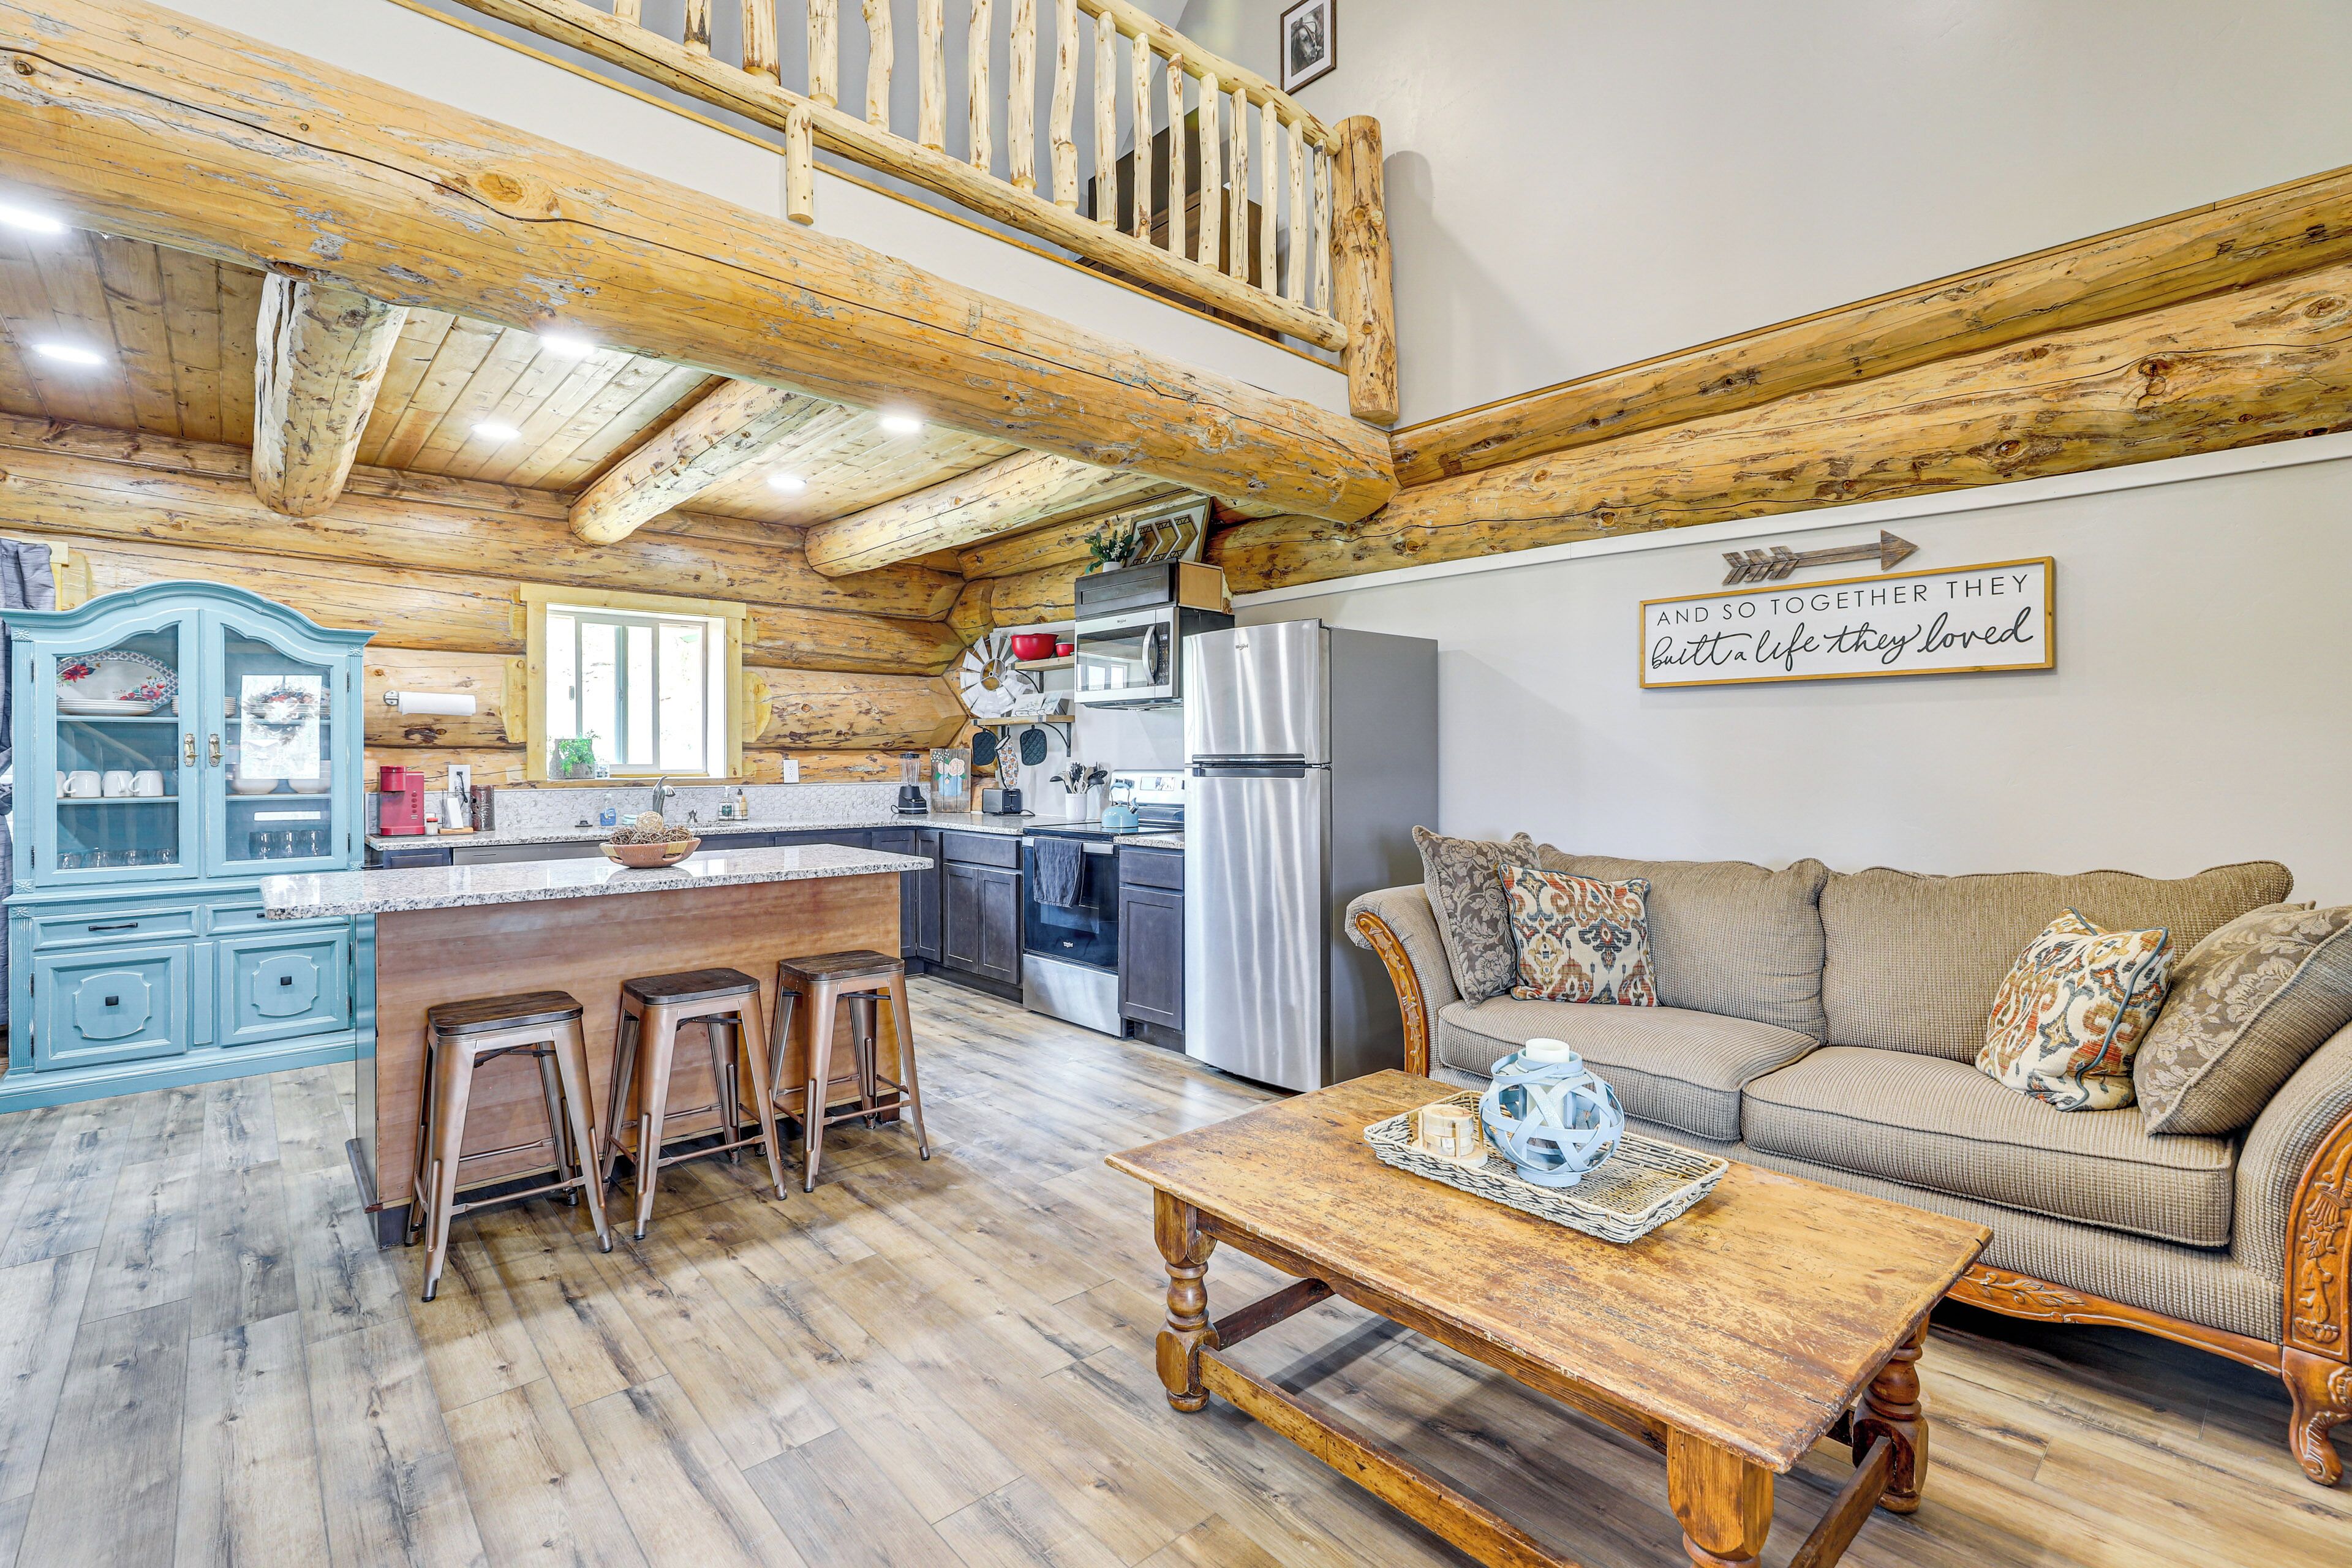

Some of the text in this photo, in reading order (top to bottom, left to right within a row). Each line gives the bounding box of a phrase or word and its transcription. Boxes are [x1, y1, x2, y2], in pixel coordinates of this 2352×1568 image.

[1657, 574, 2027, 626] AND SO TOGETHER THEY
[1651, 606, 2034, 672] built a life they loved
